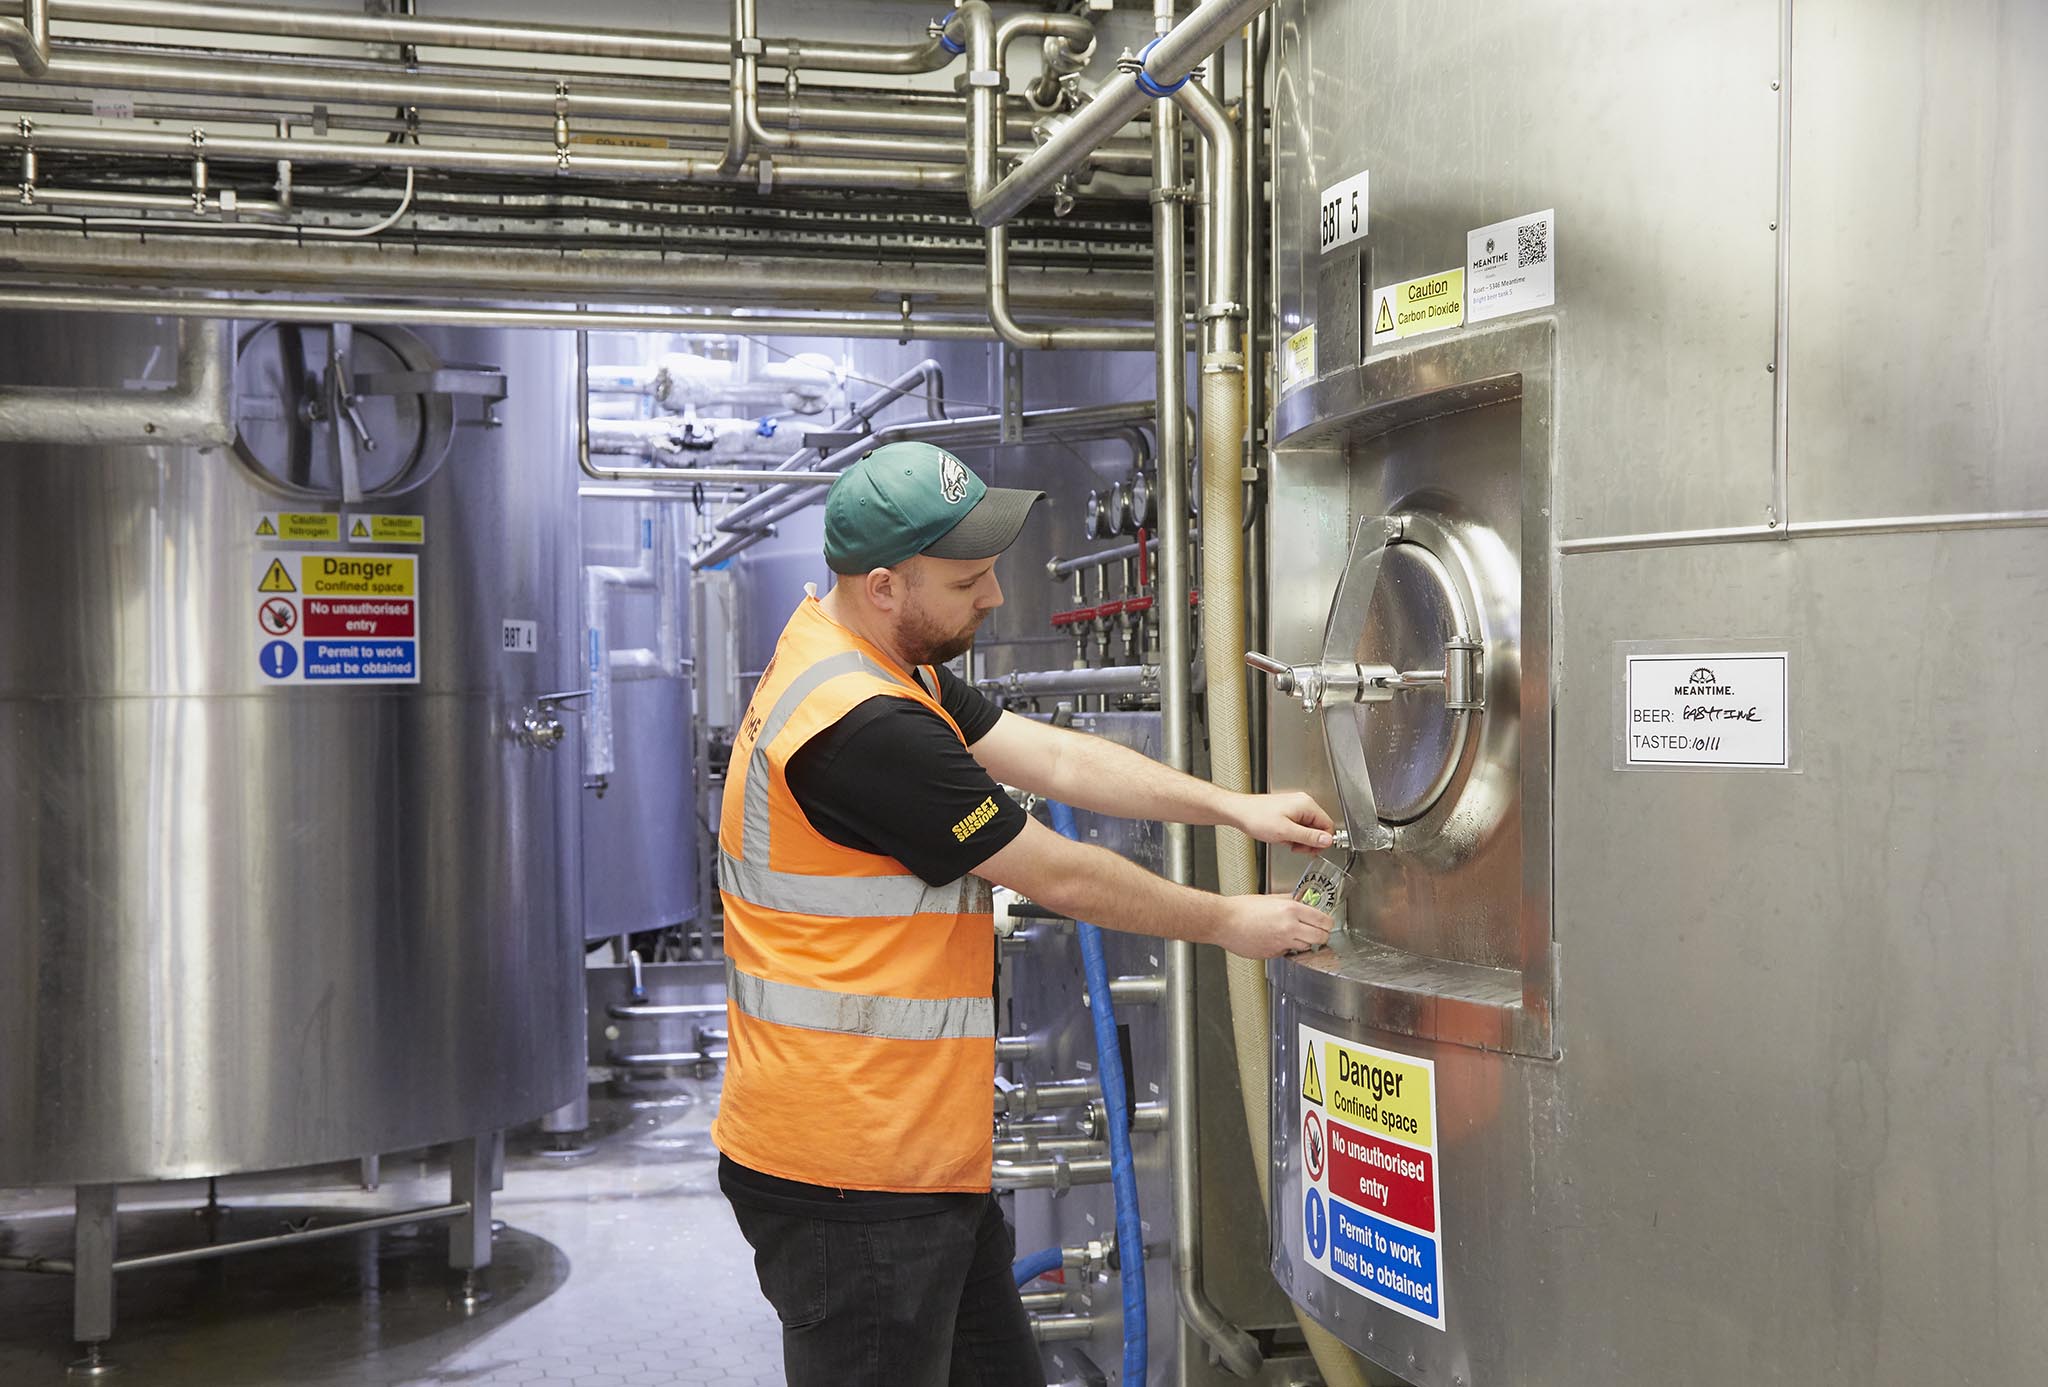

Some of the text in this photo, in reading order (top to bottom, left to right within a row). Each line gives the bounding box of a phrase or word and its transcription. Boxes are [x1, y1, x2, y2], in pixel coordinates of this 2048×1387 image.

[1322, 191, 1359, 246] BBT 5
[1473, 252, 1508, 269] MEANTIME
[1408, 280, 1448, 301] Caution
[1501, 277, 1525, 287] Meantime
[1398, 301, 1460, 325] Carbon Dioxide
[291, 515, 327, 525] Caution
[289, 527, 329, 537] Nitrogen
[324, 558, 392, 580] Danger
[315, 580, 404, 594] Confined space
[311, 602, 409, 615] No unauthorised
[346, 620, 377, 634] entry
[505, 627, 531, 648] BBT 4
[318, 645, 404, 658] Permit to work
[309, 662, 412, 674] must be obtained
[1633, 709, 1674, 723] BEER:
[1633, 735, 1692, 750] TASTED:
[952, 796, 993, 835] SUNSET
[956, 803, 999, 842] SESSIONS
[1339, 1050, 1403, 1101] Danger
[1334, 1090, 1418, 1135] Confined space
[1332, 1130, 1424, 1182] No unauthorised
[1359, 1175, 1389, 1207] entry
[1339, 1214, 1422, 1268] Permit to work
[1334, 1246, 1432, 1304] must be obtained
